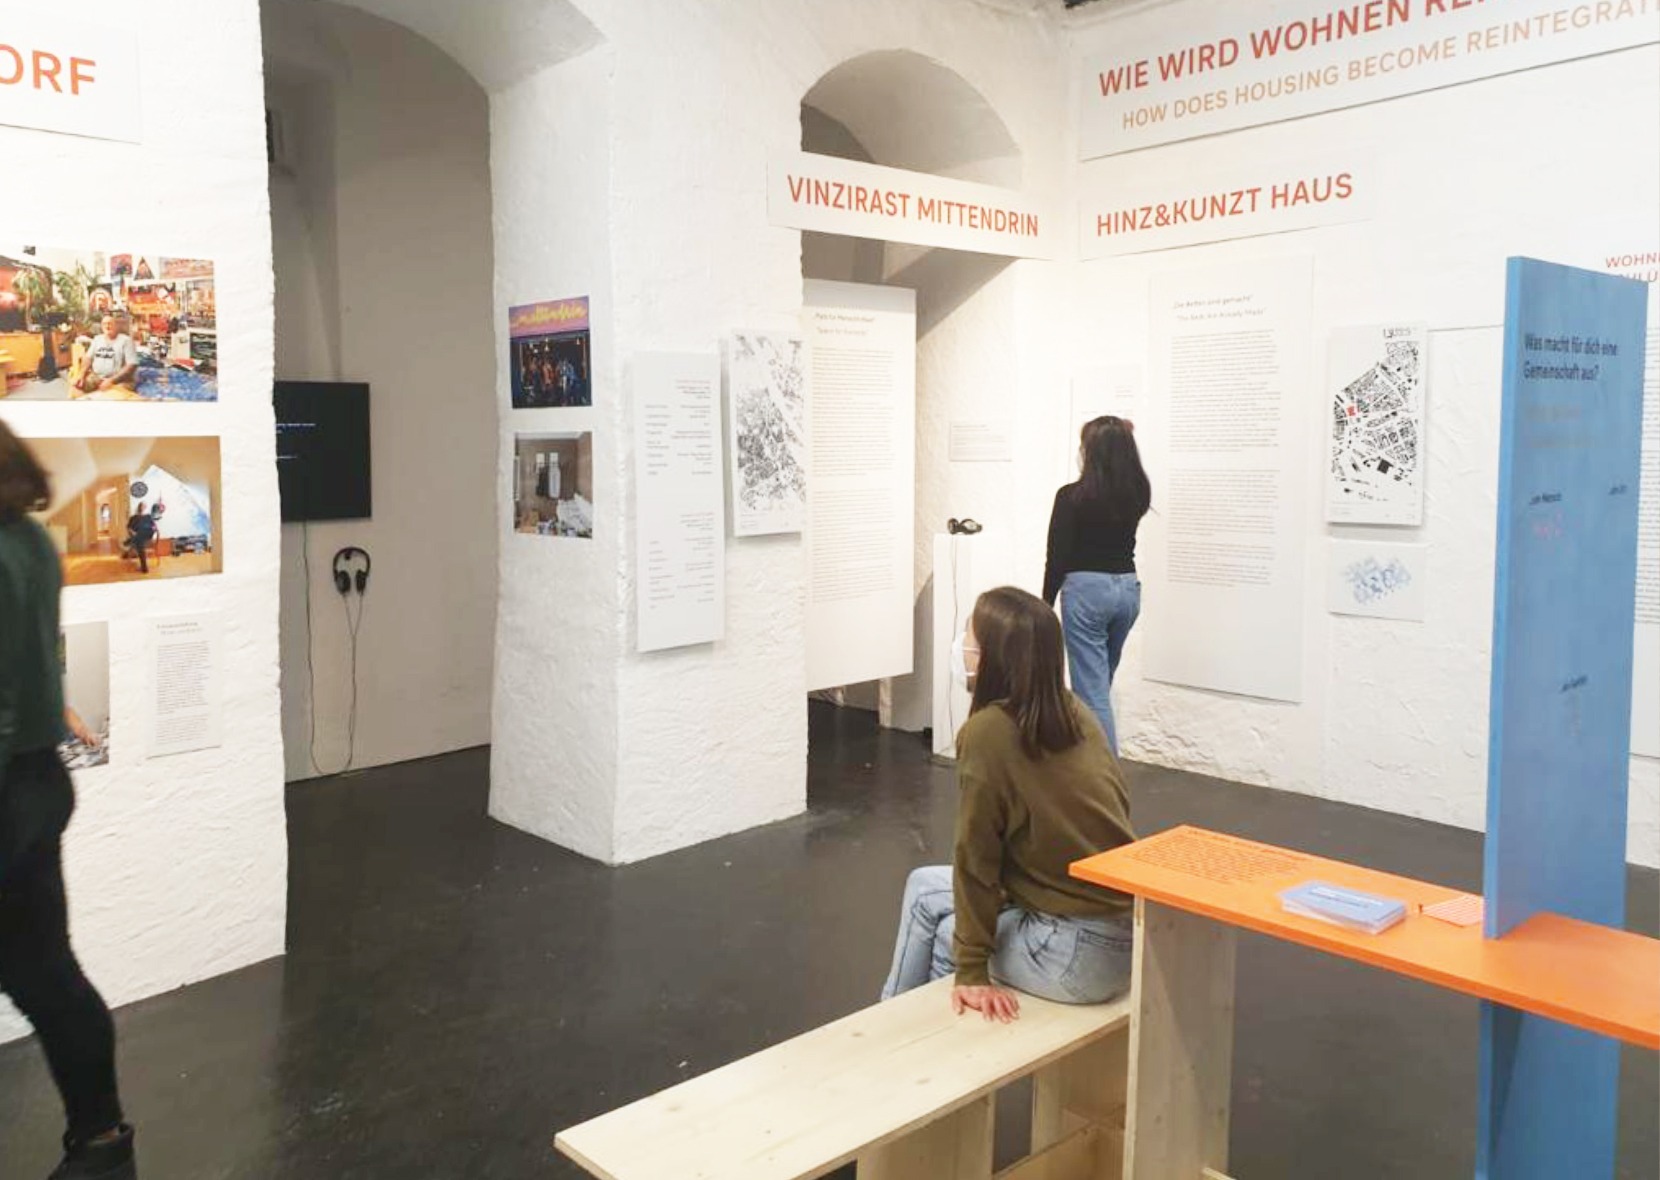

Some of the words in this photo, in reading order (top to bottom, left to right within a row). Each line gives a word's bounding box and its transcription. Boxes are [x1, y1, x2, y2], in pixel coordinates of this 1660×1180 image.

[1100, 60, 1149, 97] WIE
[1158, 38, 1239, 81] WIRD
[1250, 0, 1410, 59] WOHNEN
[1122, 103, 1168, 130] HOW
[1174, 90, 1228, 119] DOES
[1235, 65, 1339, 105] HOUSING
[1347, 36, 1457, 81] BECOME
[787, 174, 911, 218] VINZIRAST
[917, 196, 1039, 237] MITTENDRIN
[1097, 187, 1262, 237] HINZ&KUNZT
[1270, 173, 1353, 210] HAUS
[1605, 252, 1660, 268] WOHN
